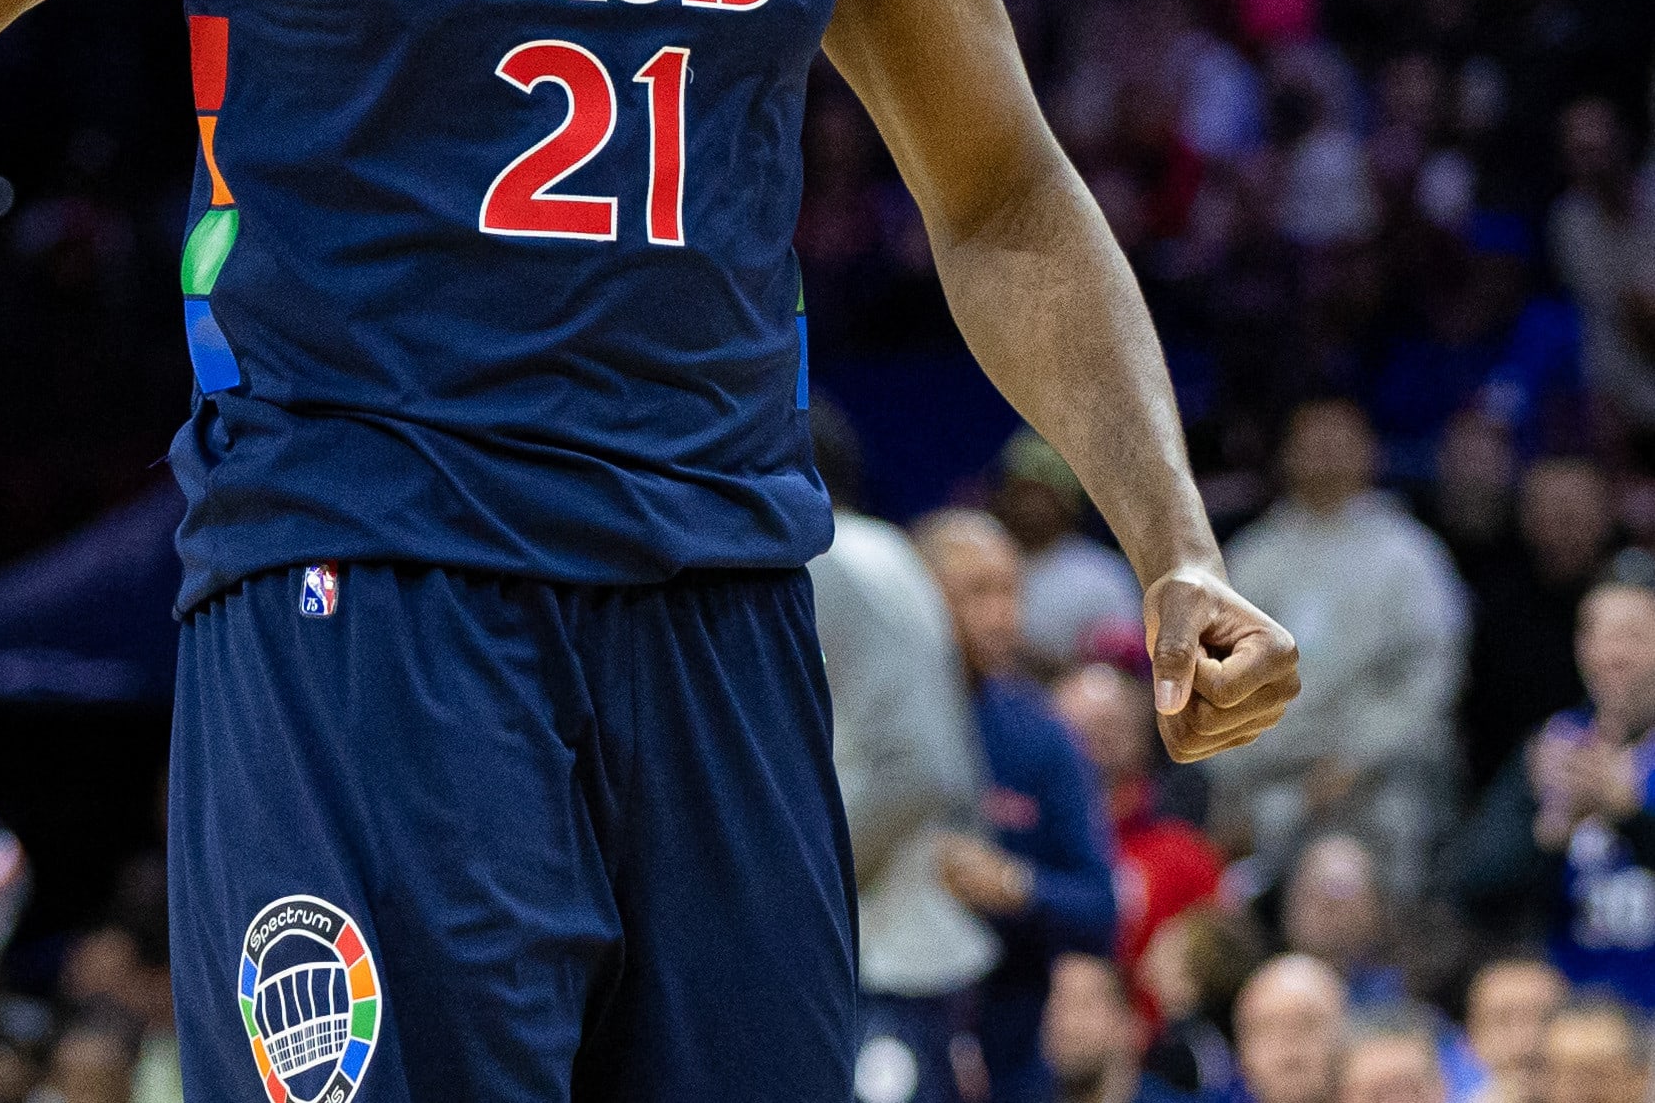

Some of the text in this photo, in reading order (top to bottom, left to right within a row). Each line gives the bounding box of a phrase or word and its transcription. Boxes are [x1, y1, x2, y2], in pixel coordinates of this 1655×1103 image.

[479, 39, 690, 246] 21
[306, 597, 319, 612] 75
[250, 906, 332, 952] Spectrum
